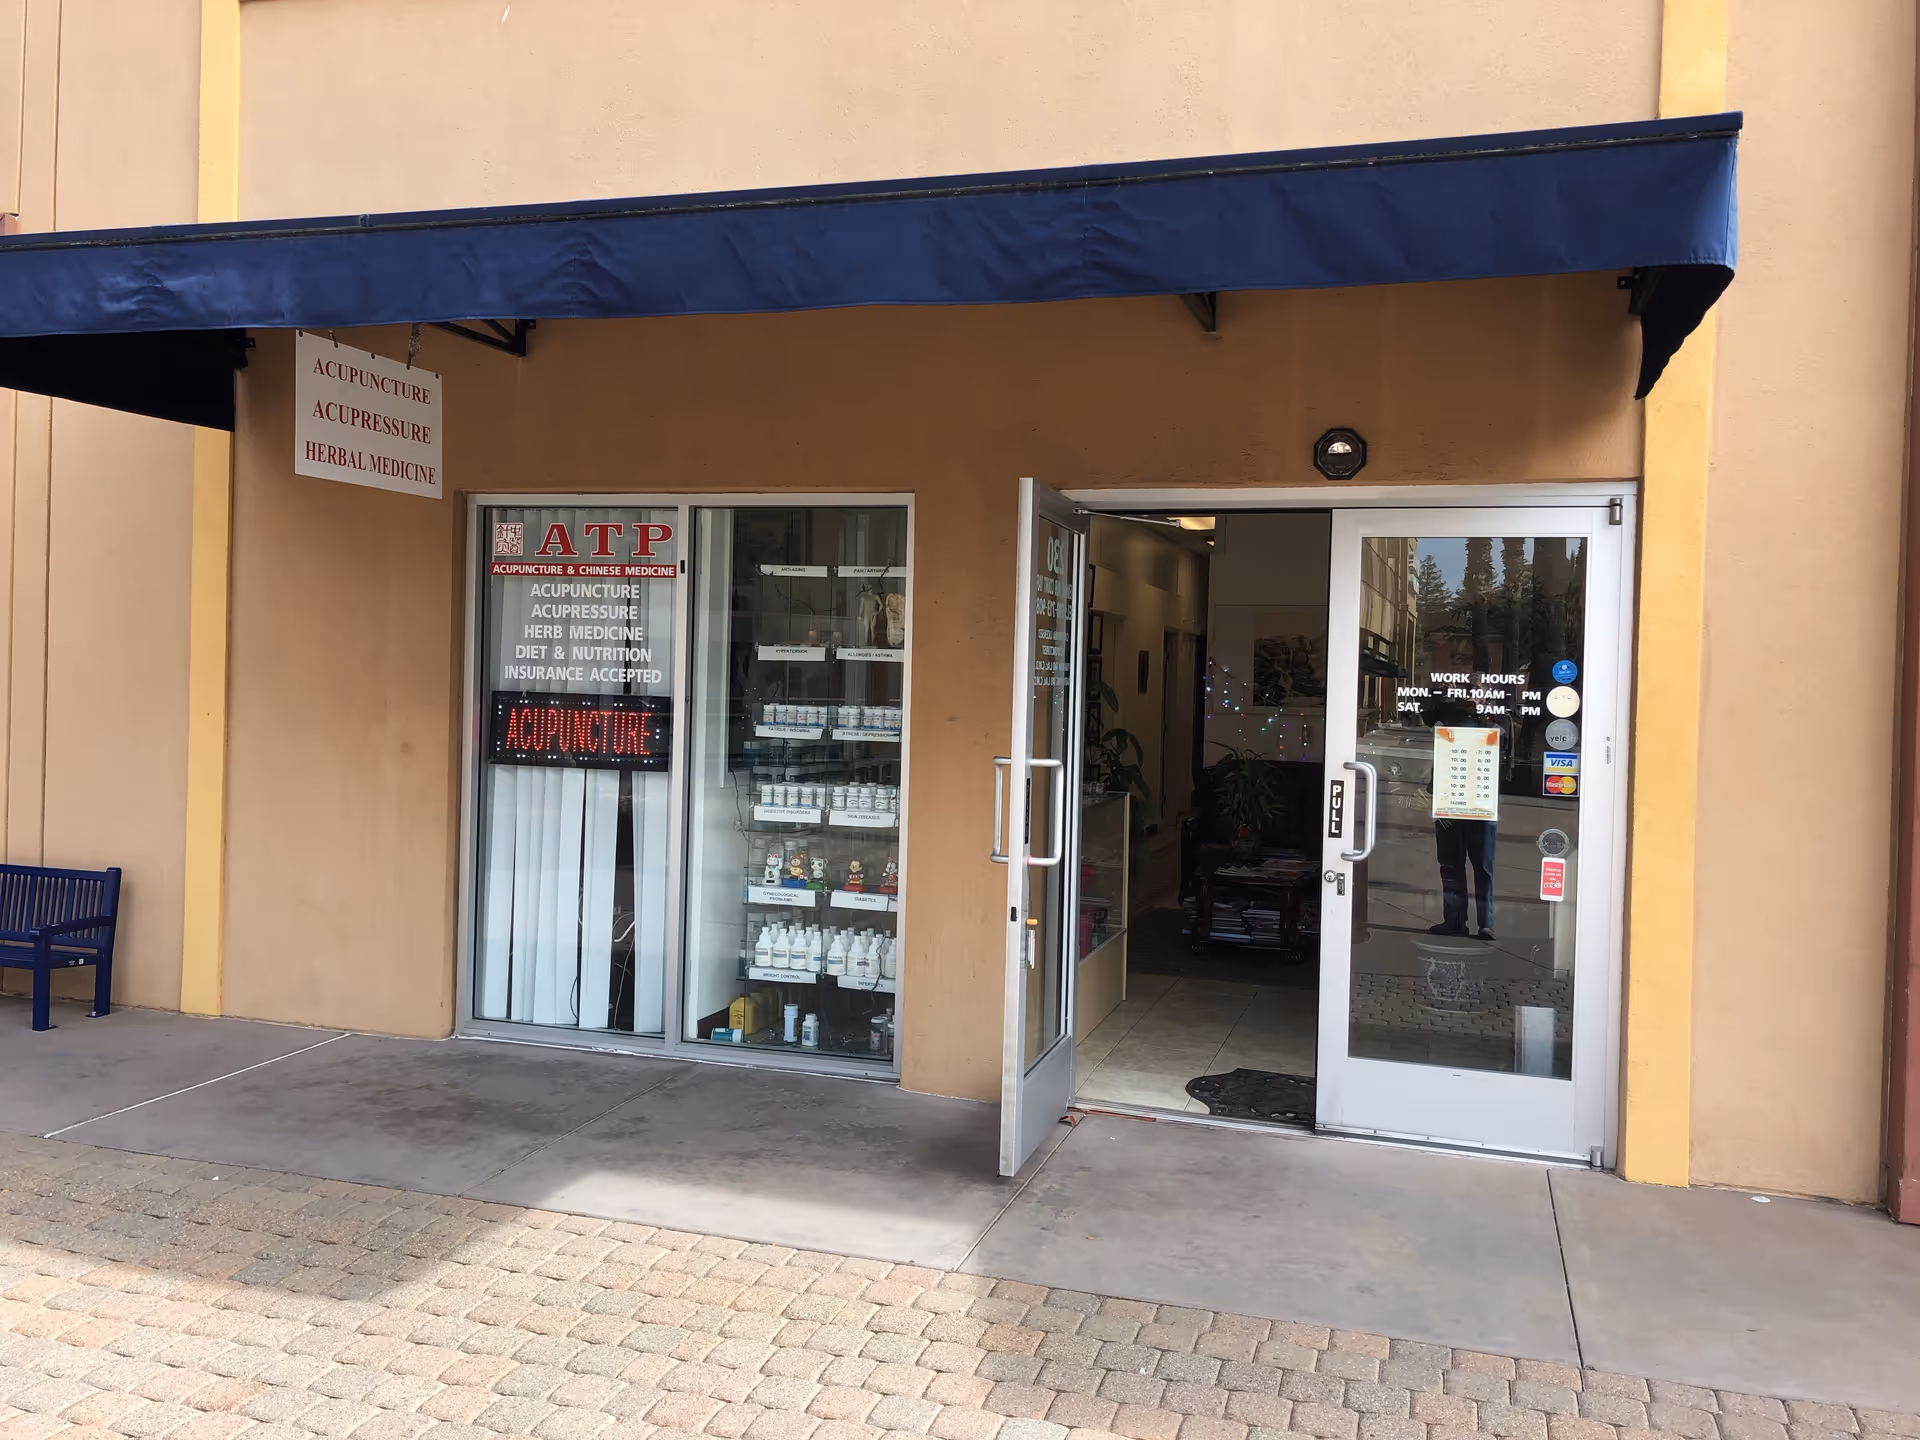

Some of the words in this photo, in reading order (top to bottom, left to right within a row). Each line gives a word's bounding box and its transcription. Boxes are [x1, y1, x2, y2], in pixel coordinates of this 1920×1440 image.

[313, 358, 431, 405] ACUPUNCTURE
[312, 400, 431, 444] ACUPRESSURE
[305, 440, 366, 471] HERBAL
[369, 454, 436, 485] MEDICINE
[535, 522, 673, 557] ATP
[493, 565, 563, 574] ACUPUNCTURE
[567, 566, 575, 575] &
[579, 566, 621, 575] CHINESE
[625, 566, 674, 576] MEDICINE
[530, 584, 640, 598] ACUPUNCTURE
[531, 604, 638, 620] ACUPRESSURE
[524, 625, 562, 639] HERB
[570, 626, 643, 641] MEDICINE
[515, 645, 547, 659] DIET
[554, 646, 565, 659] &
[572, 647, 652, 662] NUTRITION
[505, 665, 583, 681] INSURANCE
[590, 668, 662, 683] ACCEPTED
[1431, 673, 1470, 683] WORK
[1481, 674, 1525, 684] HOURS
[1397, 687, 1432, 697] MON.
[1522, 692, 1541, 700] PM
[1397, 702, 1423, 712] SAT.
[1522, 707, 1540, 716] PM
[505, 708, 652, 755] ACUPUNCTURE
[1550, 759, 1573, 767] VISA
[1331, 785, 1342, 833] PULL
